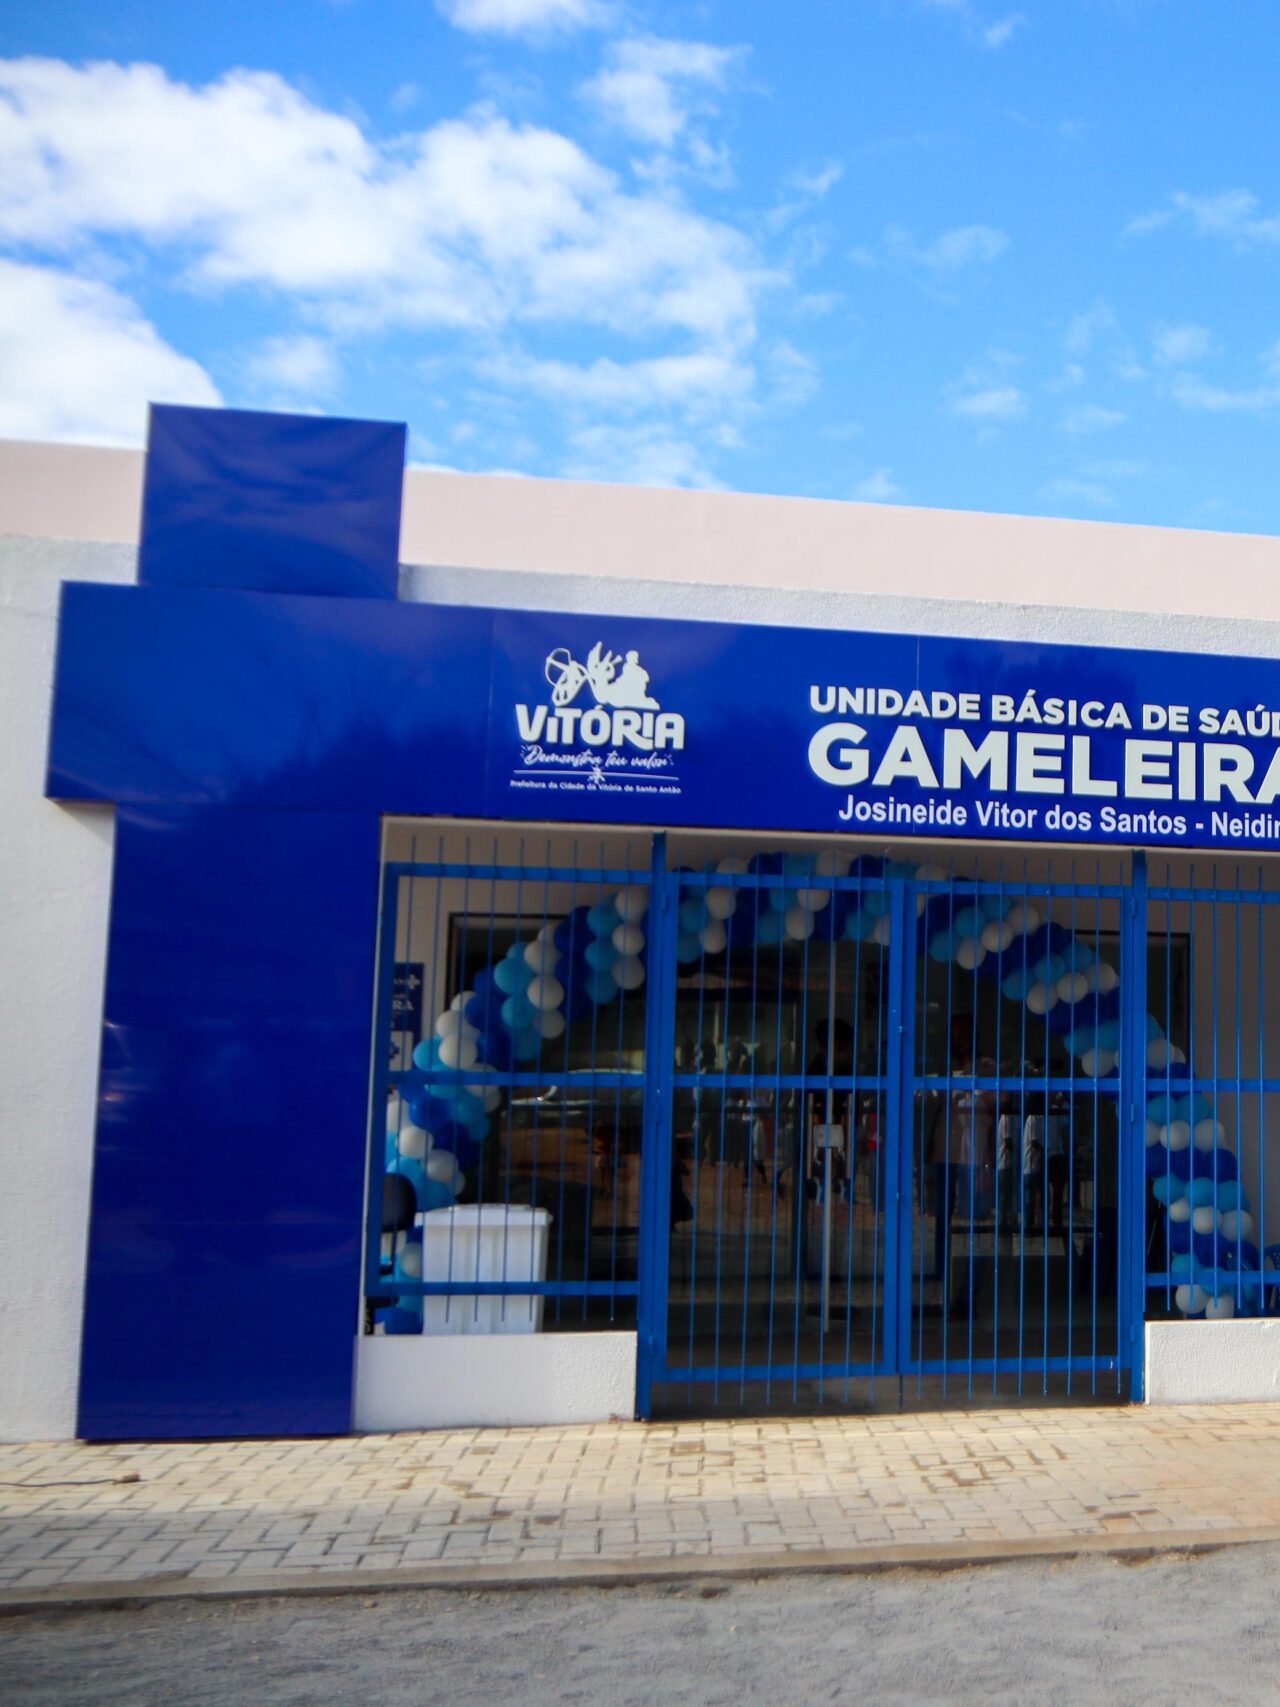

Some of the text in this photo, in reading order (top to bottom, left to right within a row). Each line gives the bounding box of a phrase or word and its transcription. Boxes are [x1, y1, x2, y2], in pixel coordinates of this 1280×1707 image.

[515, 703, 685, 751] VITÓRIA
[809, 685, 981, 720] UNIDADE
[991, 690, 1132, 730] BÁSICA
[1142, 703, 1190, 732] DE
[548, 781, 558, 789] da
[560, 781, 585, 791] Cidade
[587, 783, 597, 791] da
[624, 784, 634, 792] de
[636, 785, 657, 794] Santo
[659, 786, 681, 795] Antão
[837, 794, 967, 826] Josineide
[975, 799, 1037, 829] Vitor
[1045, 804, 1092, 832] dos
[1100, 806, 1187, 835] Santos
